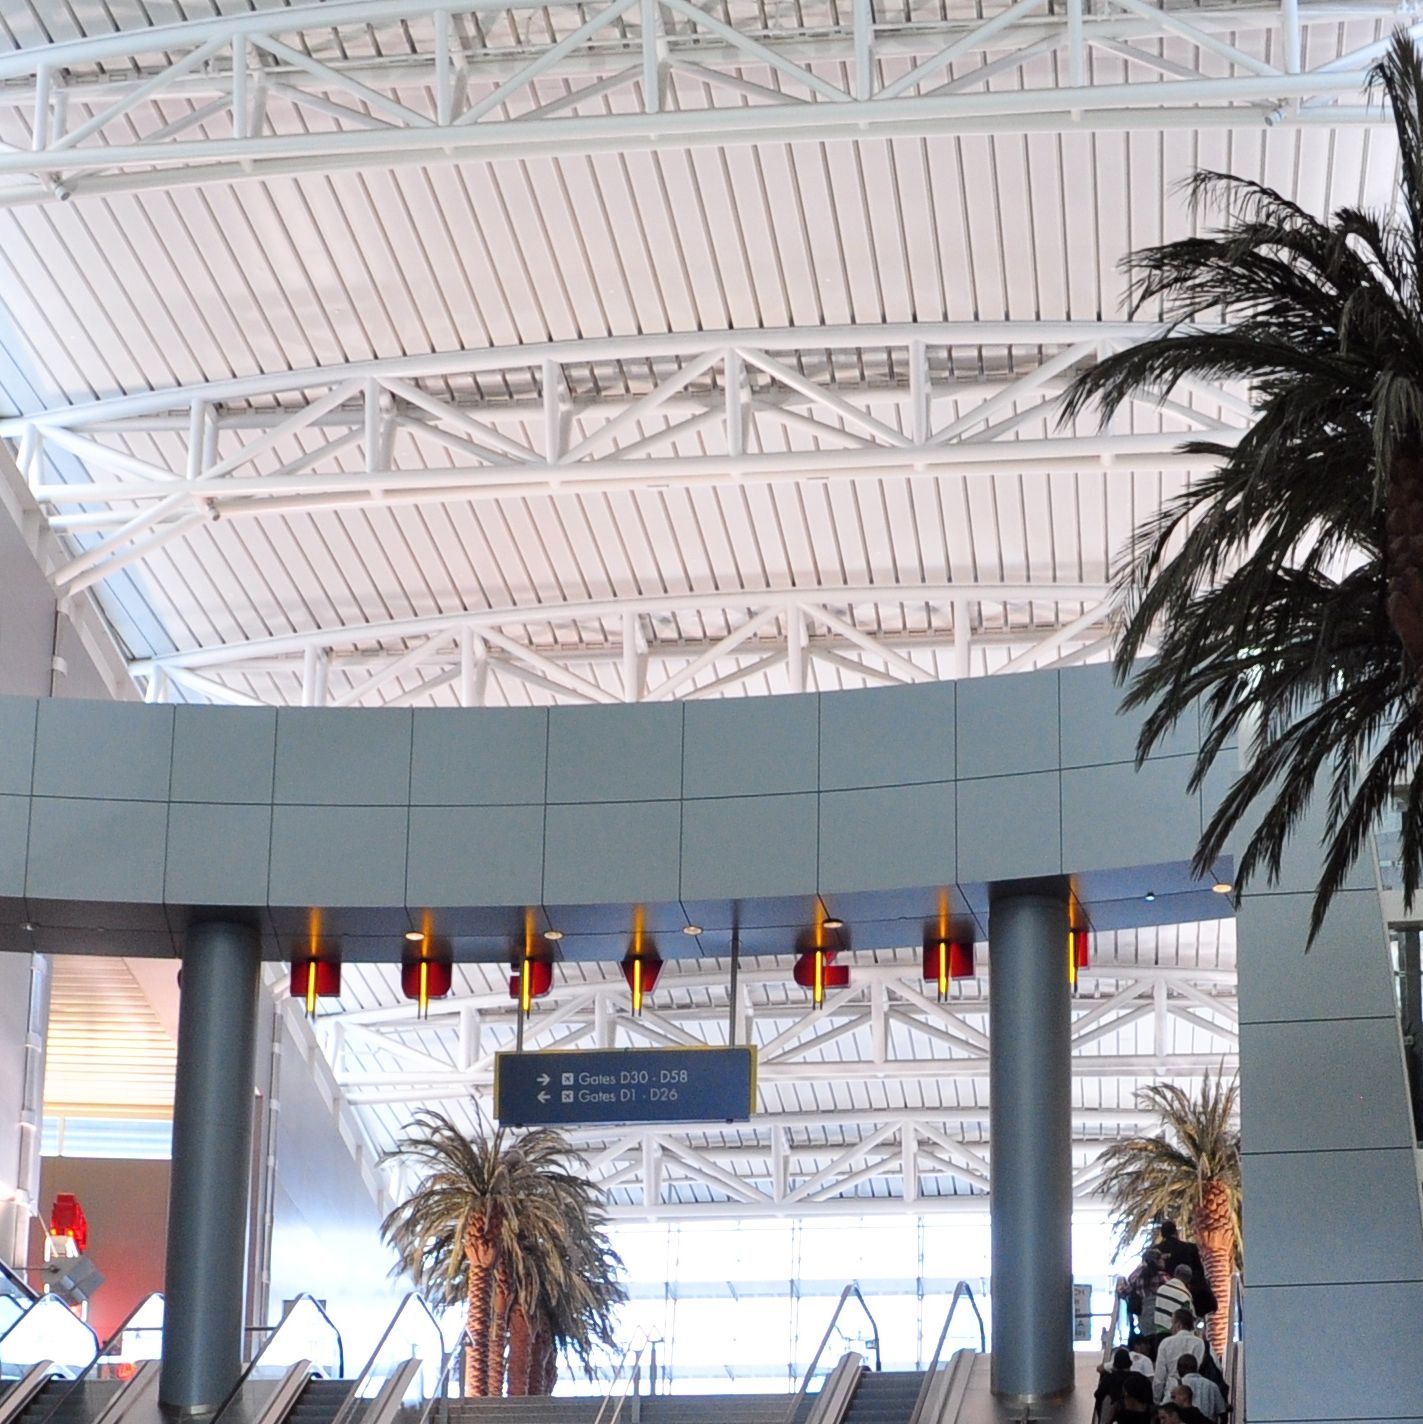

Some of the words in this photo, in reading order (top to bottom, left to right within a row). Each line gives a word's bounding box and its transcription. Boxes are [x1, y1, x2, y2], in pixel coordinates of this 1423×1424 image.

[579, 1072, 616, 1085] Gates
[620, 1071, 649, 1084] D30
[660, 1070, 688, 1083] D58
[579, 1090, 616, 1102] Gates
[620, 1089, 636, 1101] D1
[650, 1088, 678, 1101] D26
